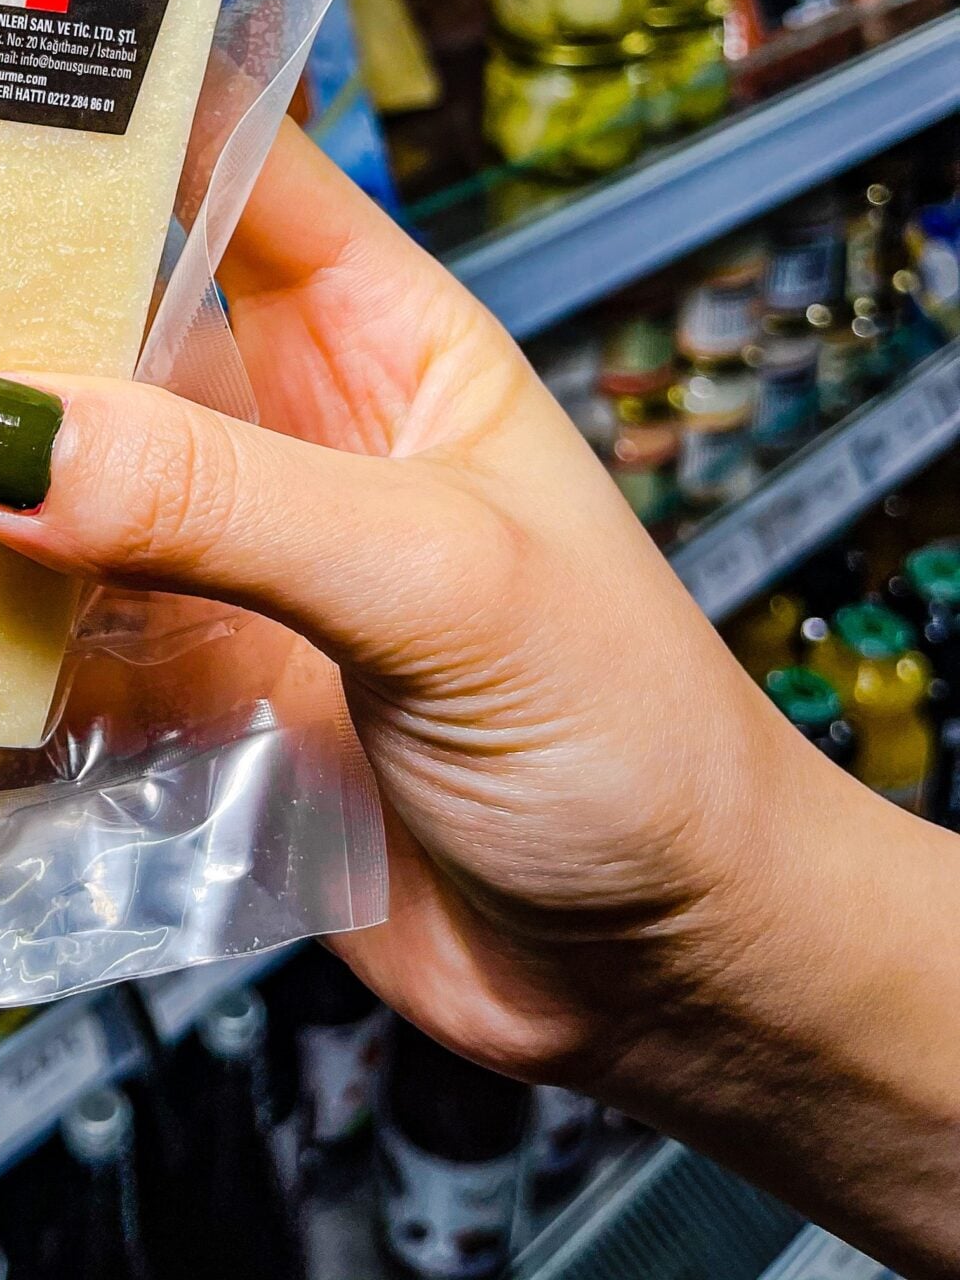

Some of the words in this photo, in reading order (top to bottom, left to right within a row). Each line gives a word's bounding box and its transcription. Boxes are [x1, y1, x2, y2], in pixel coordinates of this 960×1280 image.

[29, 17, 55, 34] SAN.
[57, 20, 71, 36] VE
[73, 22, 92, 39] TİC.
[94, 26, 116, 42] LTD.
[118, 28, 138, 46] ŞTİ.
[6, 32, 25, 48] No:
[25, 35, 38, 50] 20
[40, 36, 89, 56] Kağıthane
[97, 41, 138, 63] İstanbul
[19, 51, 132, 80] info@bonusgurme.com
[15, 86, 46, 104] HATTI
[47, 92, 70, 107] 0212
[71, 95, 89, 109] 284
[90, 98, 103, 111] 86
[103, 99, 115, 113] 01
